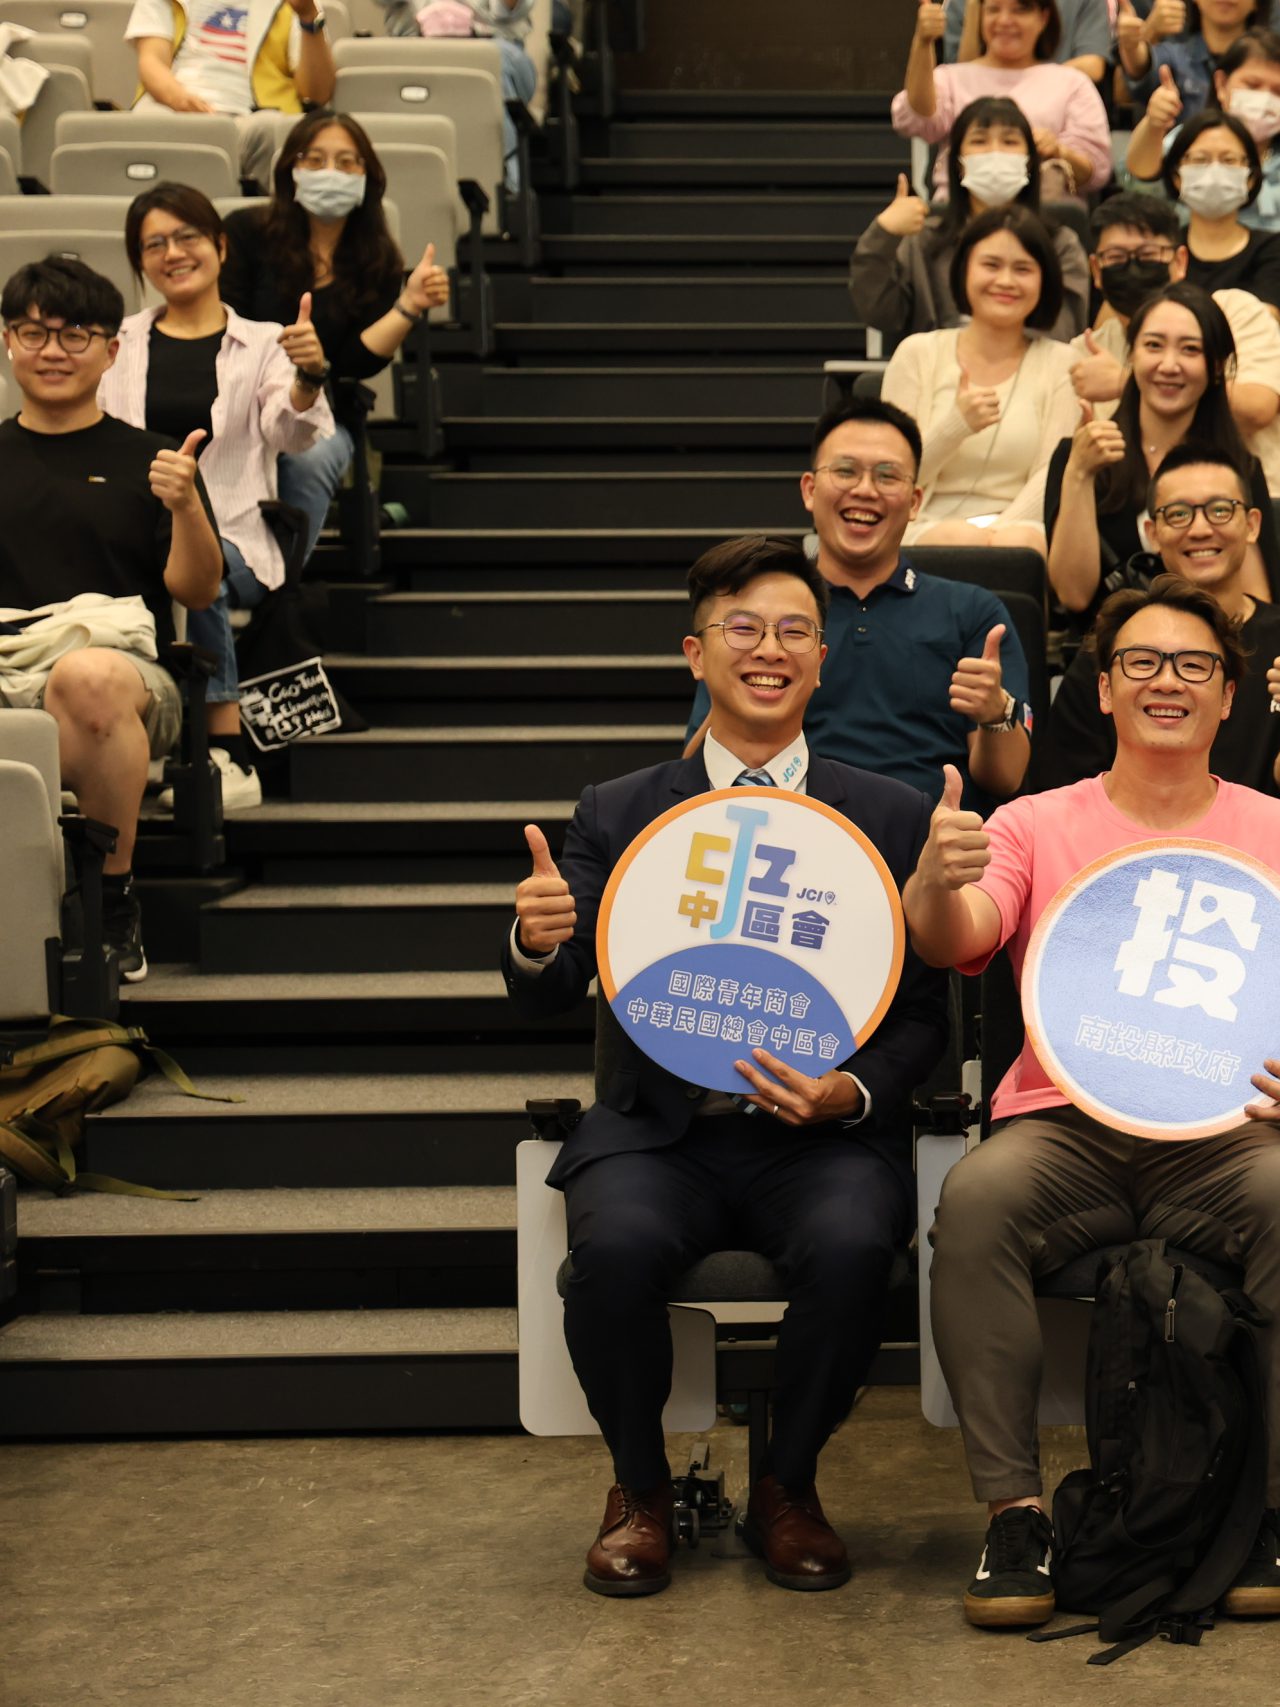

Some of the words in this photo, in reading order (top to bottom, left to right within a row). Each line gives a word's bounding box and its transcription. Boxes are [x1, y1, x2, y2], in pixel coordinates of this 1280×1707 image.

[783, 762, 797, 783] JCI
[796, 887, 823, 902] JCI
[1113, 868, 1262, 1022] 投
[668, 969, 811, 1019] 國際青年商會
[627, 997, 840, 1060] 中華民國總會中區會
[1074, 1014, 1241, 1086] 南投縣政府
